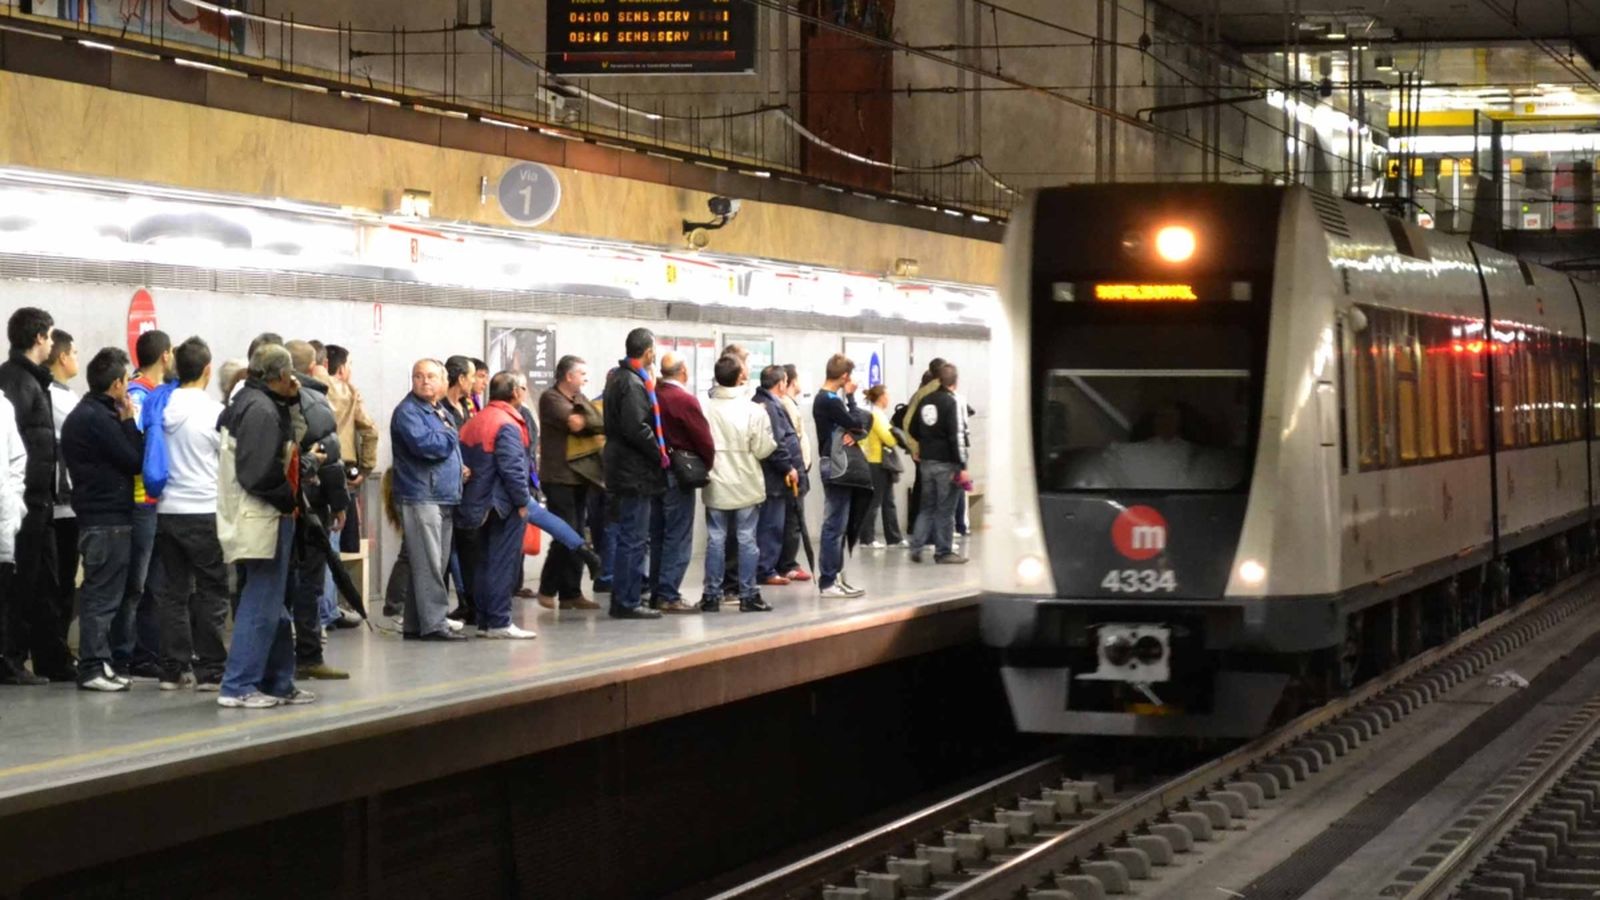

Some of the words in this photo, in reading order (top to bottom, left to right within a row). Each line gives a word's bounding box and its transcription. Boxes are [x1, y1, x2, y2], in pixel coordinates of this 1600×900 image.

[570, 12, 609, 23] 04:00
[618, 11, 690, 22] SENS.SERV
[618, 31, 690, 42] SENS.SERV
[519, 185, 532, 215] 1
[1101, 570, 1176, 592] 4334
